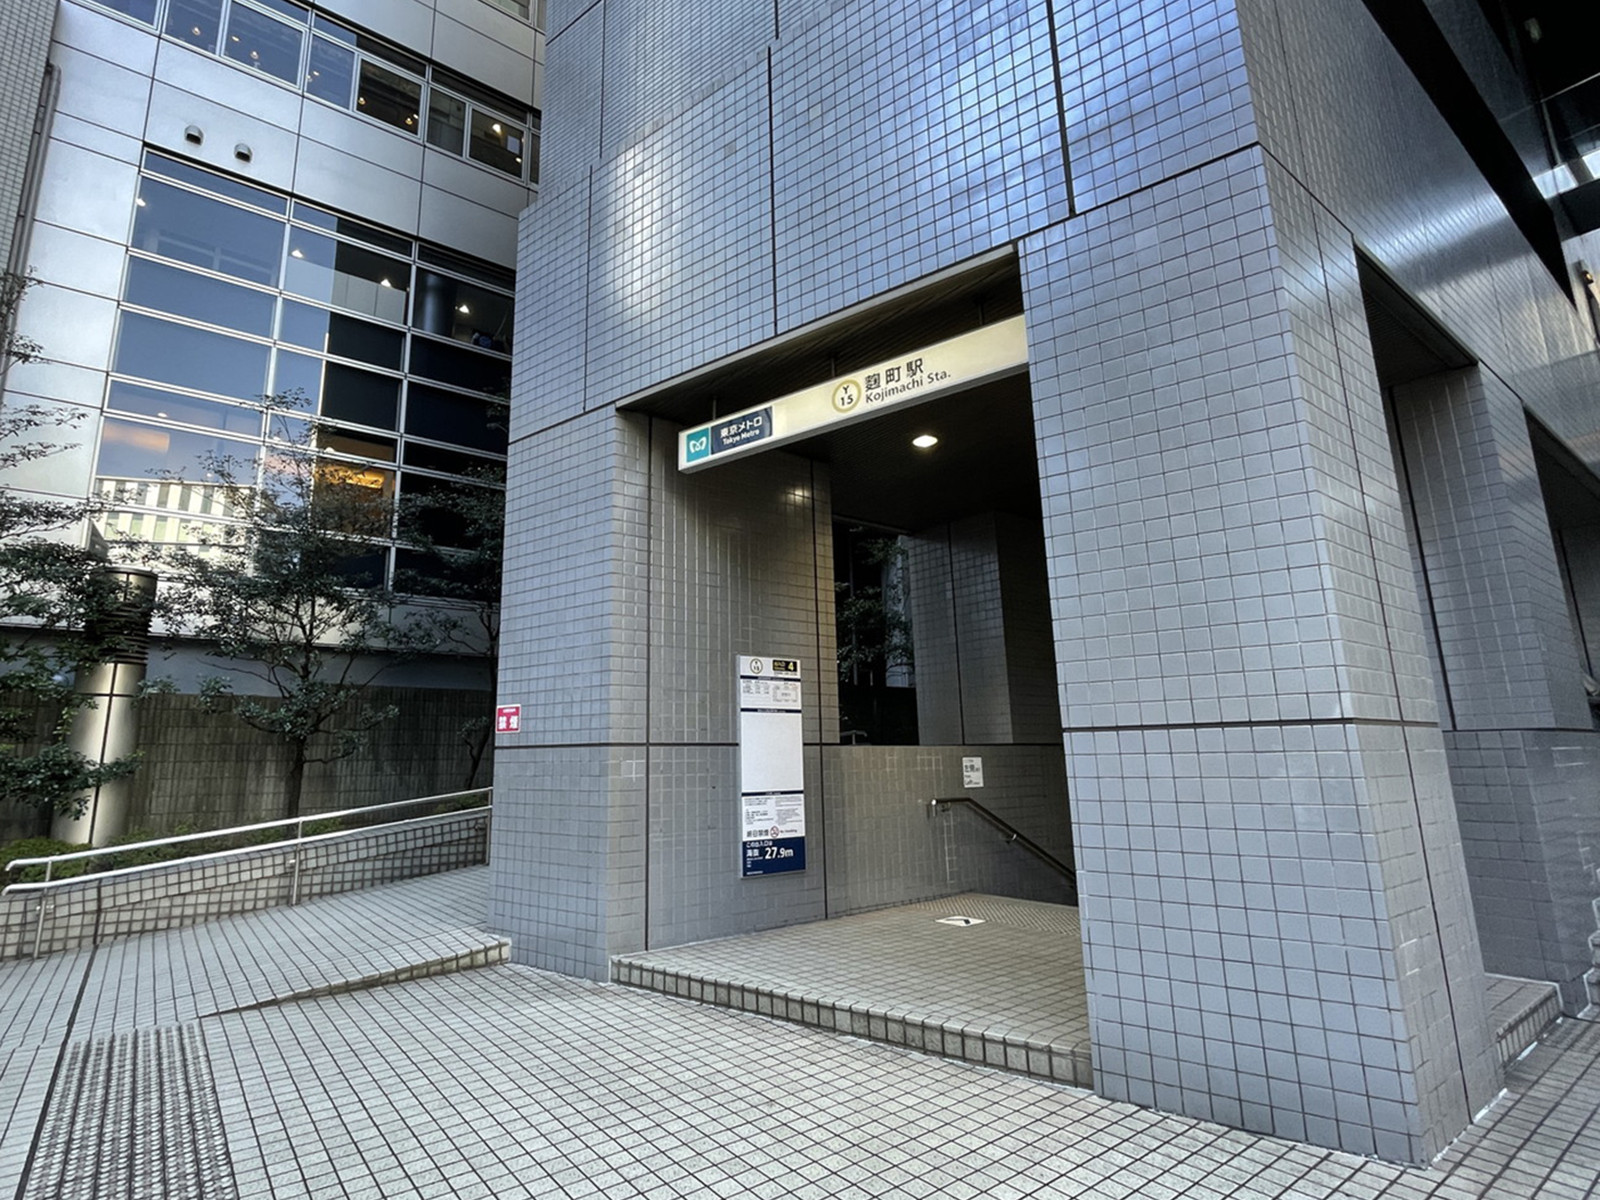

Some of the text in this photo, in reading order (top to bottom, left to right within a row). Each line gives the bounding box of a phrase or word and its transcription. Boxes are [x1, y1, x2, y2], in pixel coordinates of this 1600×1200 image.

[842, 385, 850, 394] Y
[866, 370, 951, 403] Kojimachi Sta.
[840, 394, 854, 406] 15
[720, 416, 763, 438] 東京メトロ
[722, 428, 760, 445] Tokyo Metro
[787, 662, 795, 671] 4
[764, 846, 794, 860] 27.9m
